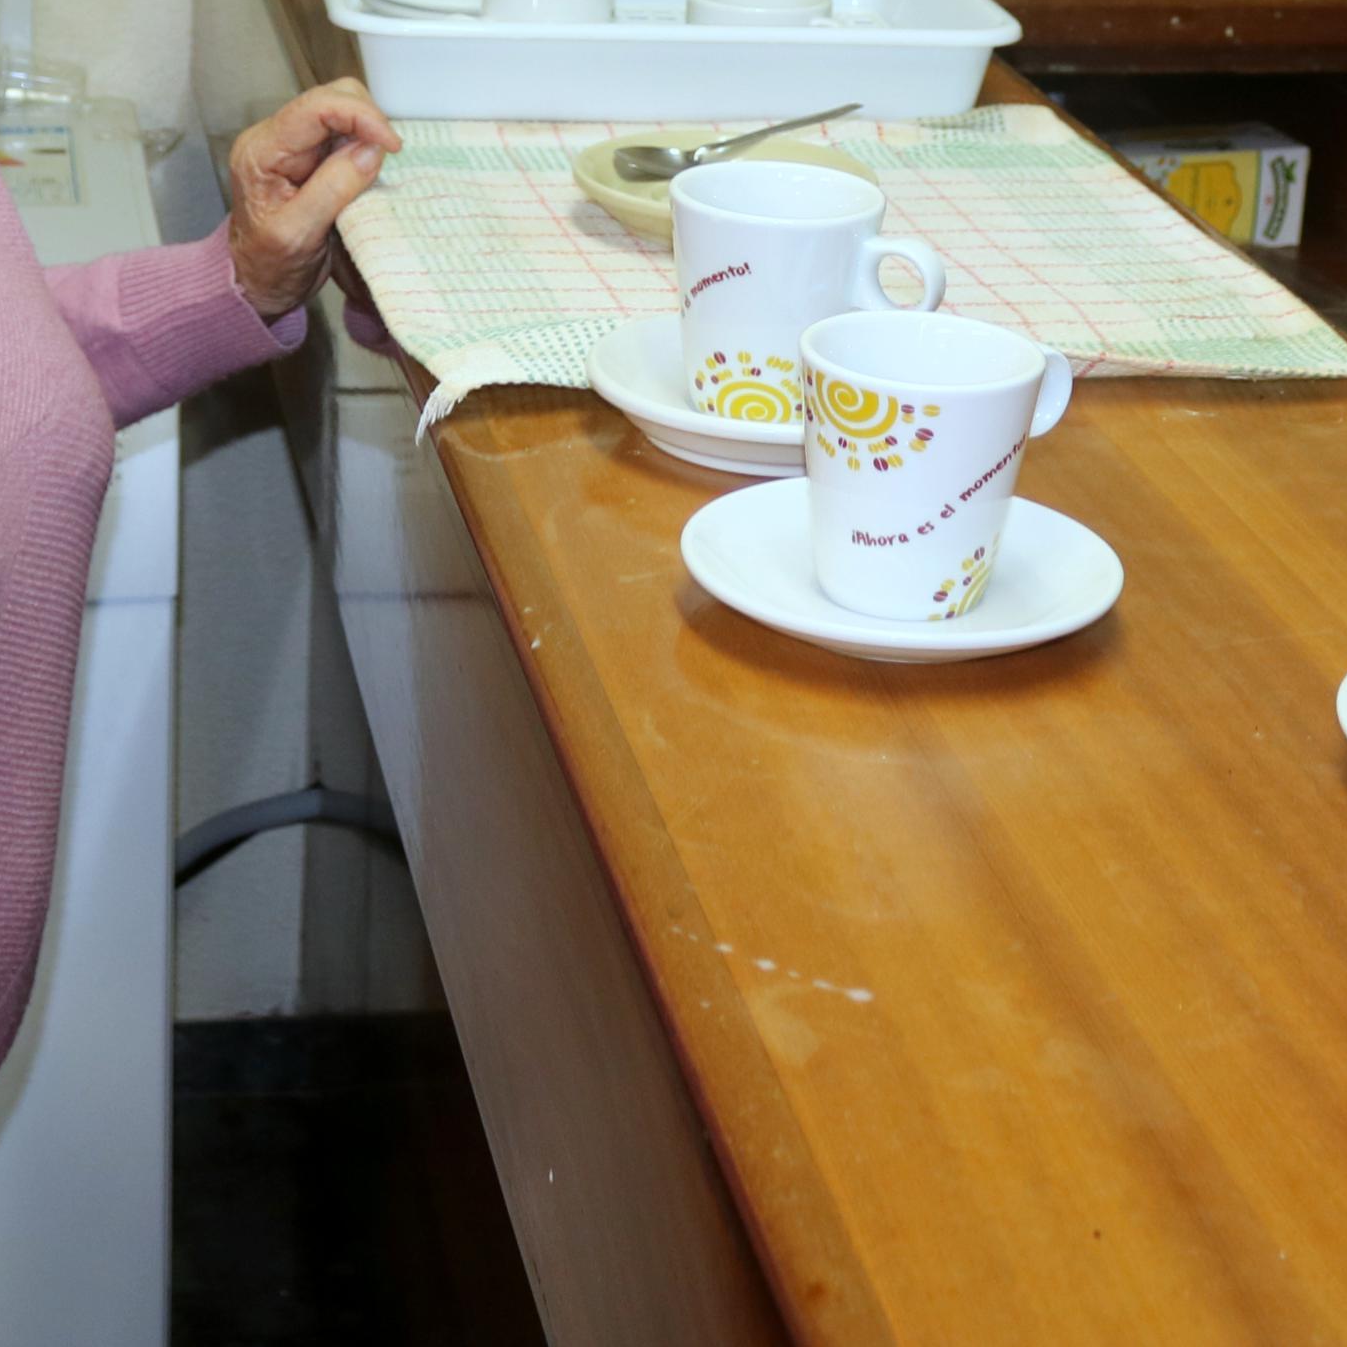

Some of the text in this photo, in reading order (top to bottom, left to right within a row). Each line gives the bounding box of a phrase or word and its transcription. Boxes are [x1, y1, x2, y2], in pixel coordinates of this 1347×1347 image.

[689, 262, 752, 297] momento!
[917, 520, 934, 536] es
[940, 504, 955, 519] el
